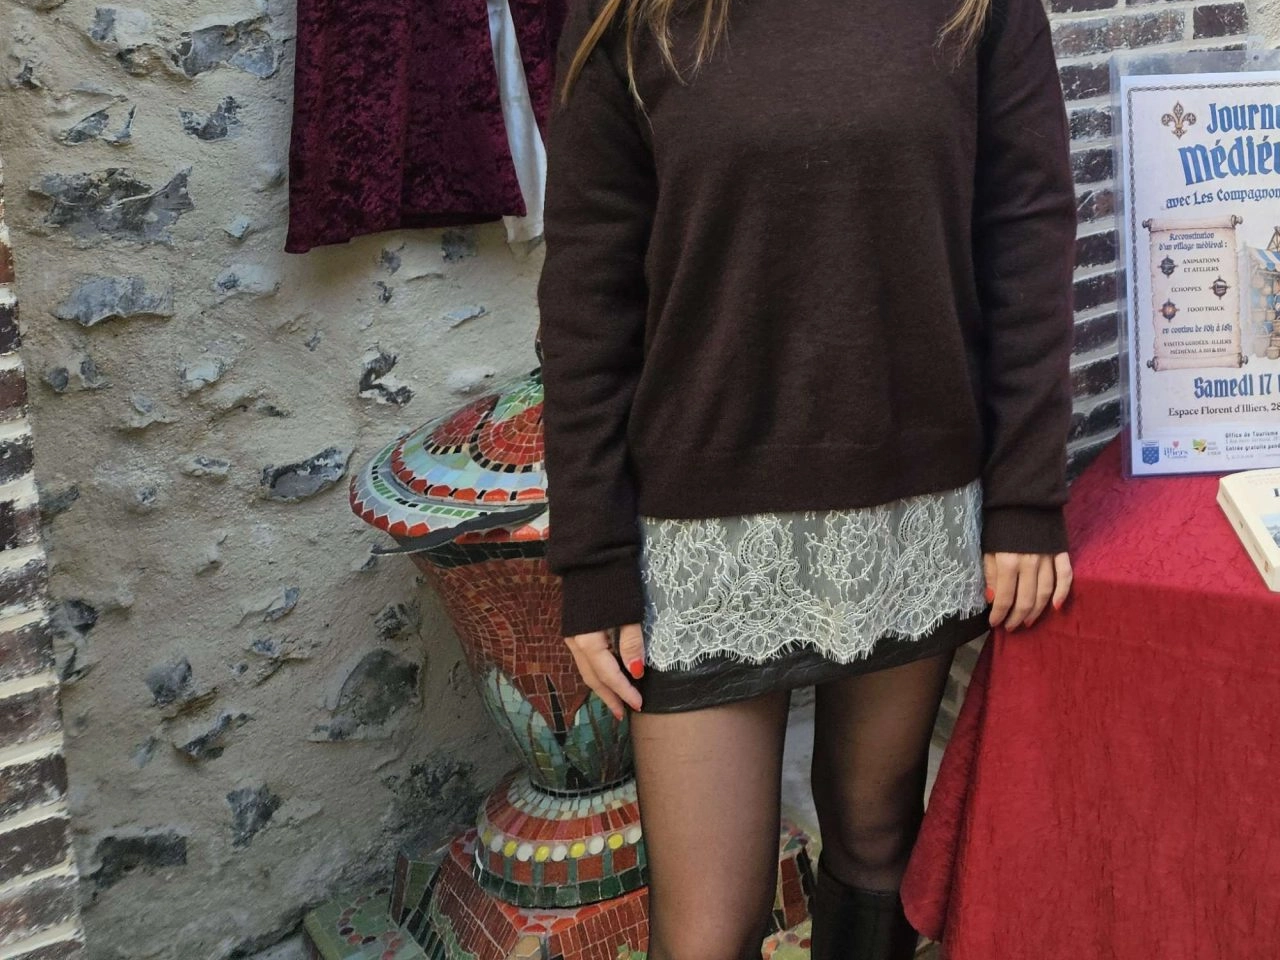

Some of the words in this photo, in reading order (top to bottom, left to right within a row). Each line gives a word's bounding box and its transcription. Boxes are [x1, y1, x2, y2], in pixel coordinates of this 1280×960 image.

[1166, 194, 1190, 209] avec
[1194, 191, 1214, 205] Les
[1169, 232, 1214, 241] Reconstitution
[1174, 242, 1194, 251] village
[1194, 373, 1254, 398] Samedi
[1258, 373, 1272, 395] 17
[1168, 407, 1199, 418] Espace
[1201, 405, 1233, 415] Florent
